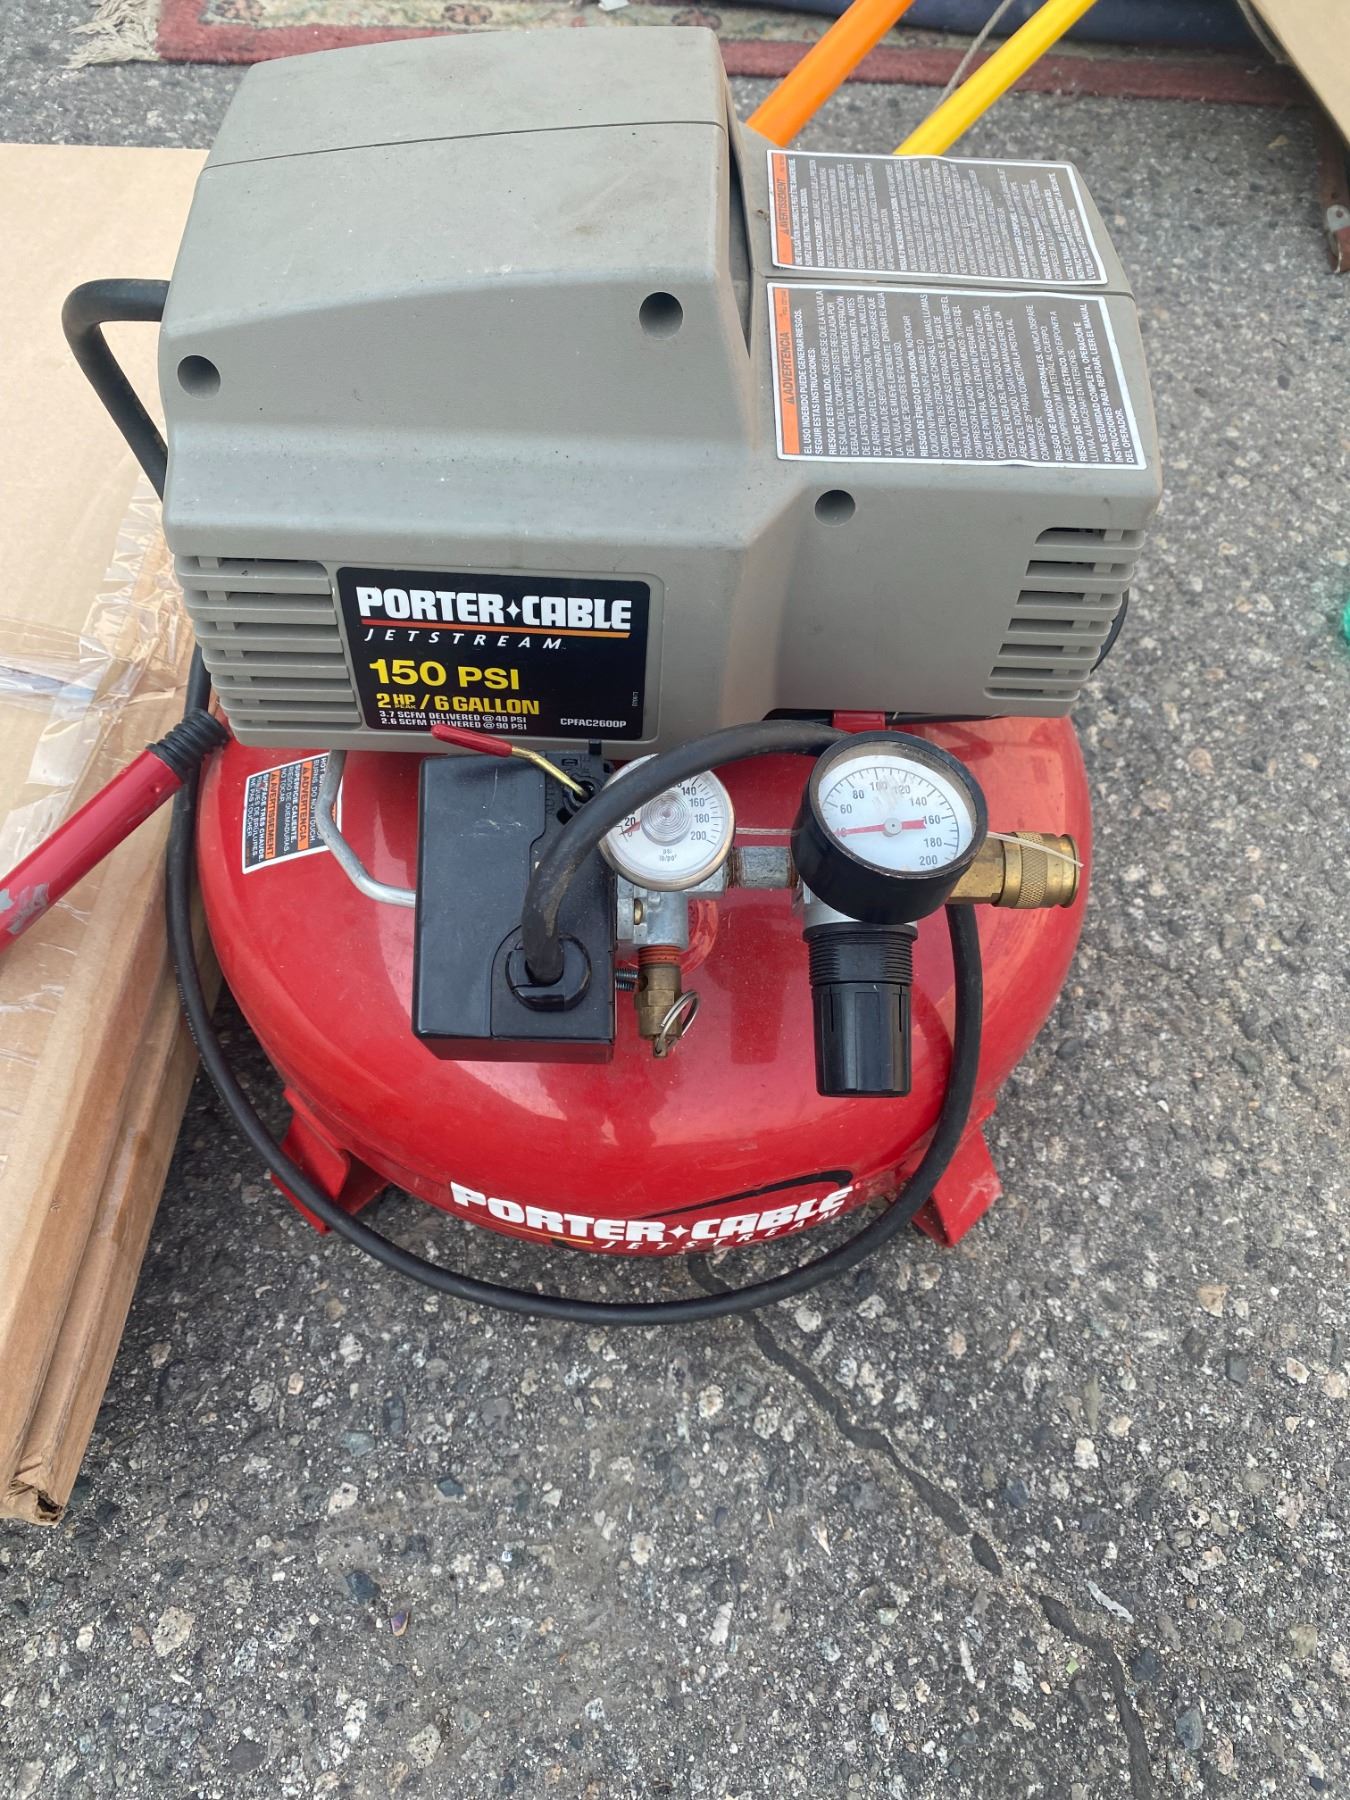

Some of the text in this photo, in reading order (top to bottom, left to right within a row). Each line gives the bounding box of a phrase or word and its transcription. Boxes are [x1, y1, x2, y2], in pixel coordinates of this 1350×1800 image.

[795, 309, 803, 337] RIESGOS.
[1025, 304, 1037, 329] DISPARE
[1079, 304, 1092, 329] MANUAL
[1030, 330, 1042, 352] NUNCA
[1087, 338, 1098, 354] LEER
[780, 333, 793, 395] ADVERTENCIA
[797, 339, 806, 369] GENERAR
[799, 370, 807, 392] PUEDE
[913, 395, 924, 418] FUEGO
[1099, 388, 1110, 405] PARA
[800, 394, 810, 427] INDEBIDO
[812, 404, 821, 426] ESTAS
[1067, 395, 1080, 423] CHOQUE
[1092, 403, 1108, 442] SEGURIDAD
[814, 427, 823, 454] SEGUIR
[827, 428, 837, 454] RIESGO
[918, 430, 929, 456] RIESGO
[1103, 406, 1124, 462] INSTRUCCIONES
[1051, 434, 1064, 460] RIESGO
[1075, 435, 1088, 461] RIESGO
[1101, 443, 1113, 462] PARA
[356, 586, 632, 630] PORTER CABLE
[364, 628, 562, 650] JETSTREAM
[369, 658, 519, 690] 150 PSI
[376, 693, 391, 708] 2
[393, 693, 416, 706] HP
[435, 695, 450, 711] 6
[453, 696, 540, 715] GALLON
[379, 710, 394, 718] 3.7
[398, 711, 426, 719] SCFM
[429, 711, 480, 721] DELIVERED
[399, 718, 427, 726] SCFM
[560, 718, 627, 728] CPFAC2600P
[682, 787, 697, 796] 140
[689, 798, 705, 807] 160
[852, 790, 864, 799] 80
[910, 796, 927, 806] 140
[267, 782, 277, 856] AVERTISSEMENT
[299, 775, 309, 842] ADVERTENCIA
[694, 814, 710, 823] 180
[840, 804, 852, 814] 60
[923, 815, 941, 824] 160
[624, 817, 636, 826] 20
[690, 831, 707, 841] 200
[924, 837, 942, 847] 180
[920, 855, 938, 866] 200
[450, 1181, 853, 1242] PORTER CABLE
[601, 1207, 841, 1251] JETSTREAM
